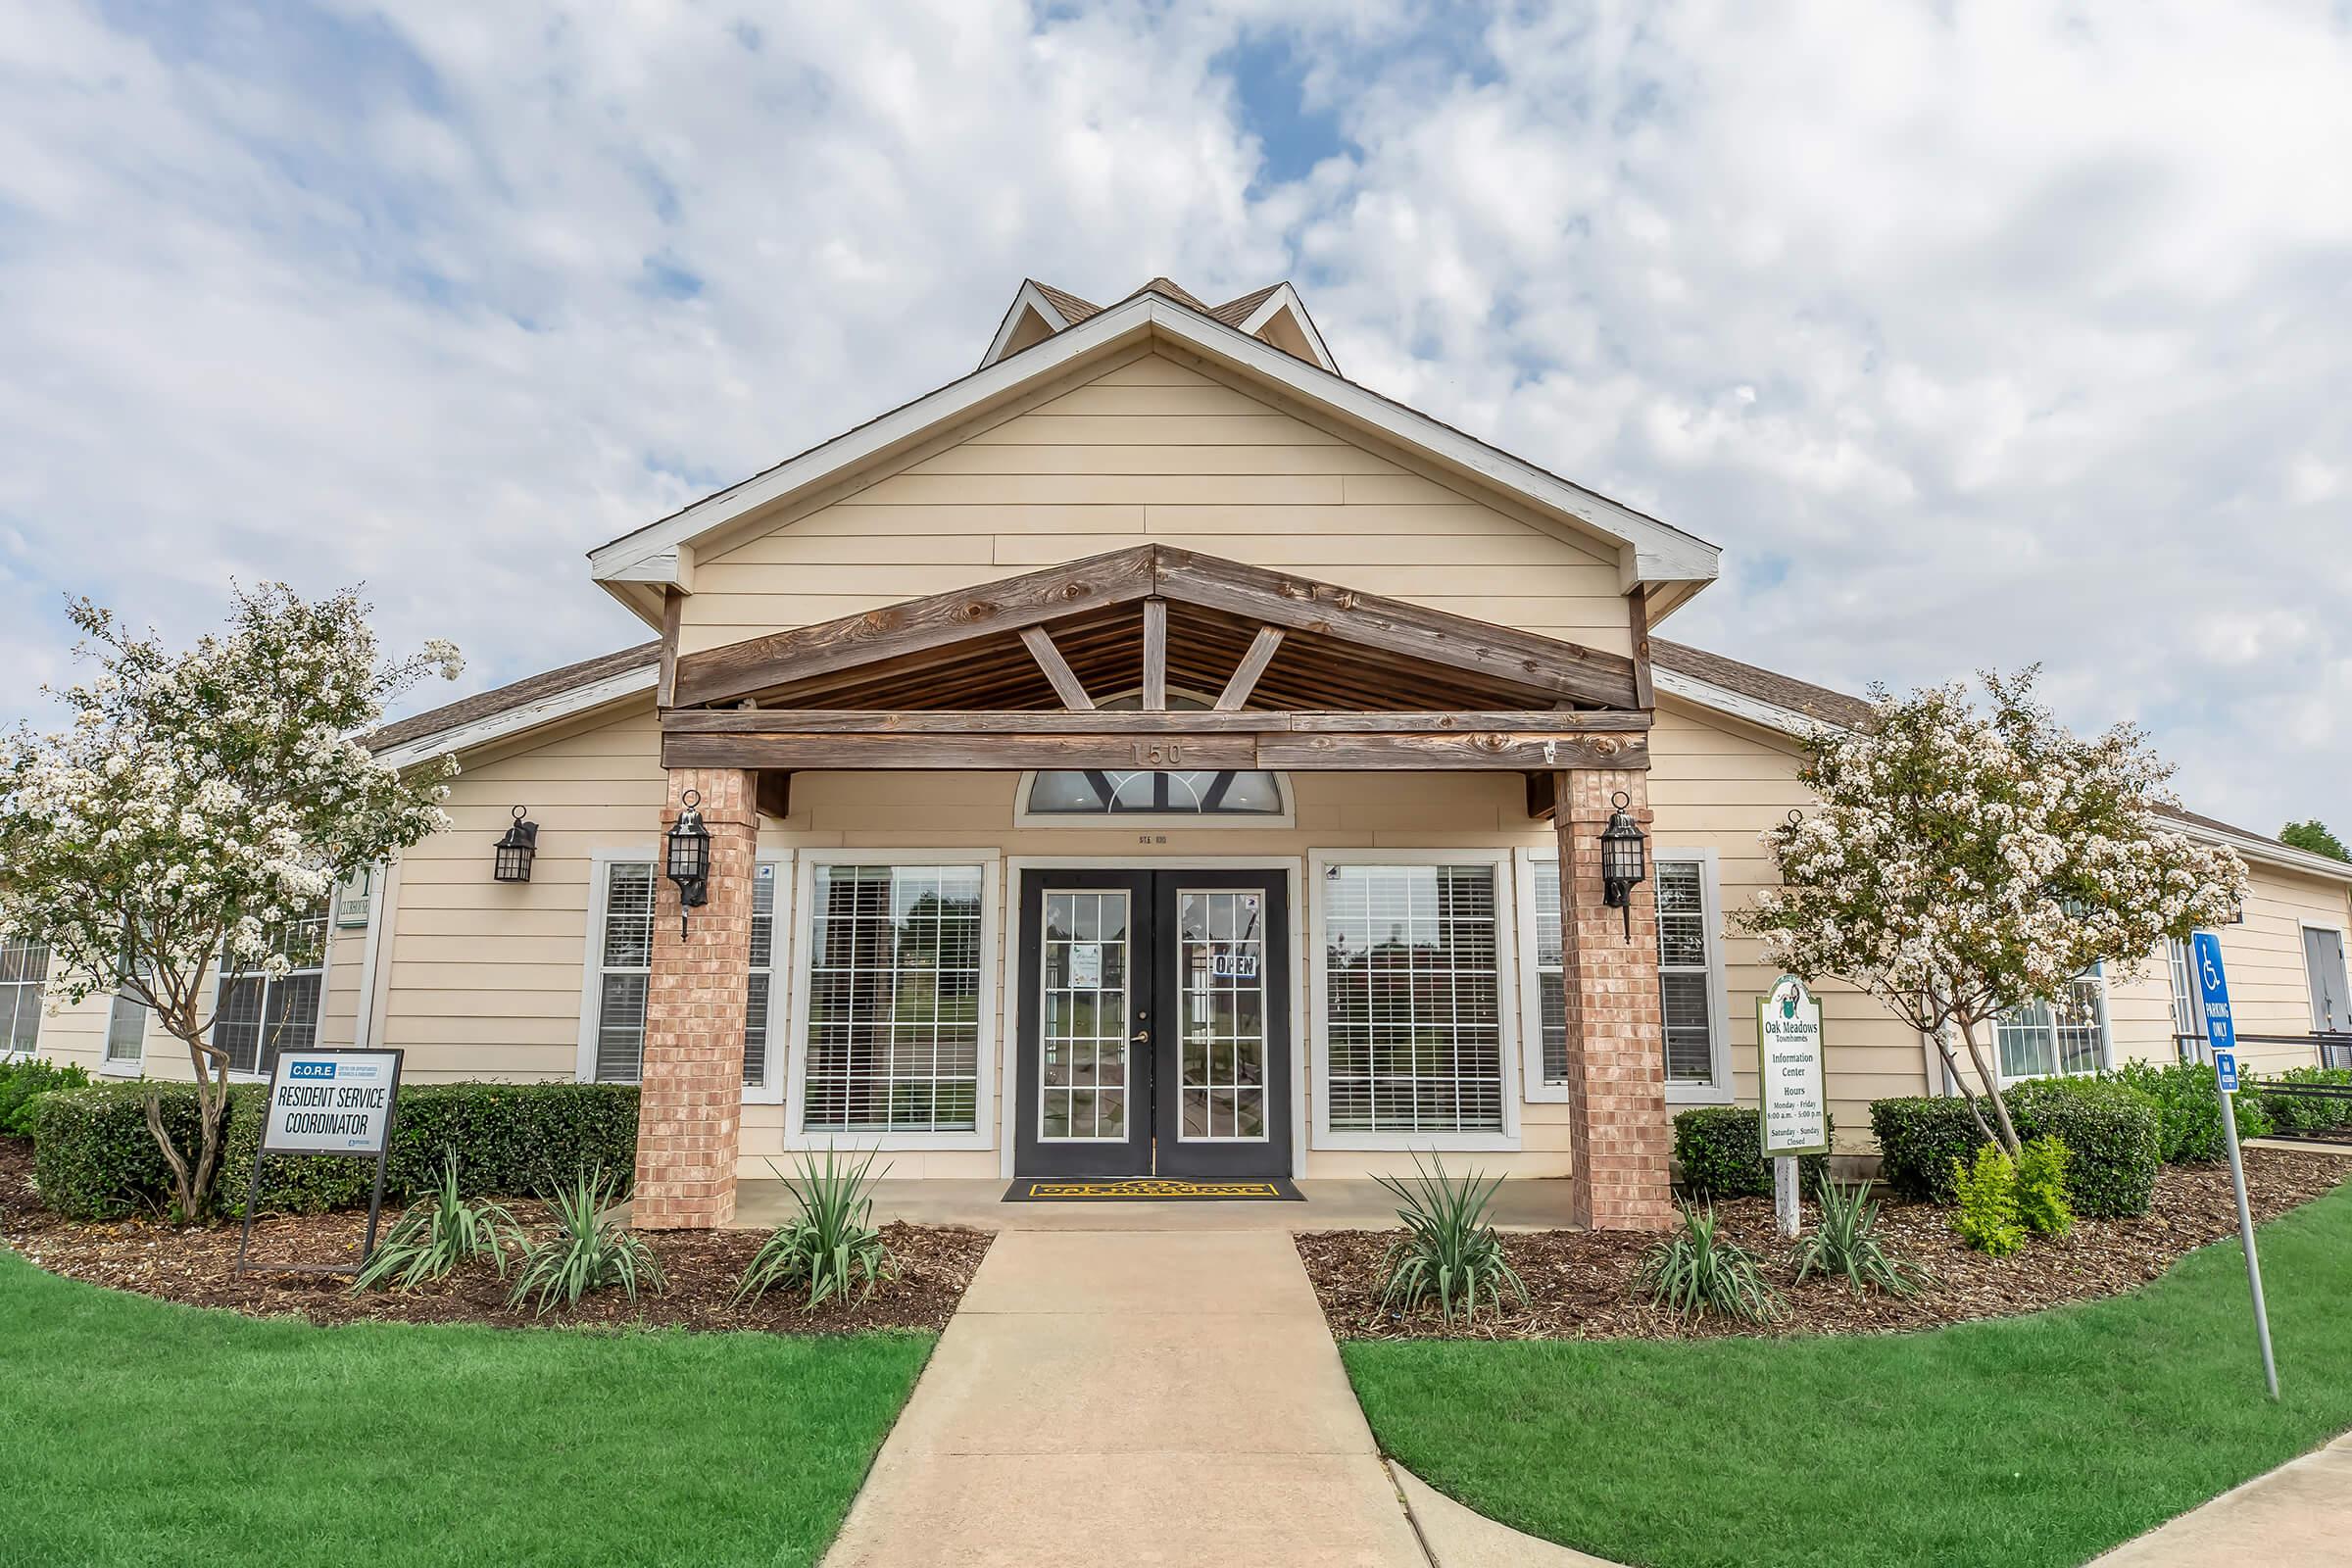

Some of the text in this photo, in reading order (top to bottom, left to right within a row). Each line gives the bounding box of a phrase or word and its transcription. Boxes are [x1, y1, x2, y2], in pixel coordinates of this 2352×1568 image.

[1131, 743, 1182, 764] 150
[1216, 956, 1254, 974] OPEN
[2205, 1003, 2229, 1018] PARKING
[1765, 1020, 1818, 1034] Oak Meadows
[2212, 1021, 2227, 1037] ONLY
[1776, 1034, 1808, 1043] Townhomes
[1772, 1053, 1813, 1063] Information
[292, 1065, 334, 1077] C.O.R.E.
[1782, 1067, 1805, 1077] Center
[277, 1086, 385, 1108] RESIDENT SERVICE
[1784, 1087, 1805, 1096] Hours
[1774, 1101, 1795, 1110] Monday
[1799, 1100, 1816, 1109] Friday
[285, 1112, 368, 1136] COORDINATOR
[1771, 1128, 1795, 1137] Saturday
[1799, 1127, 1820, 1136] Sunday
[1787, 1137, 1805, 1146] Closed
